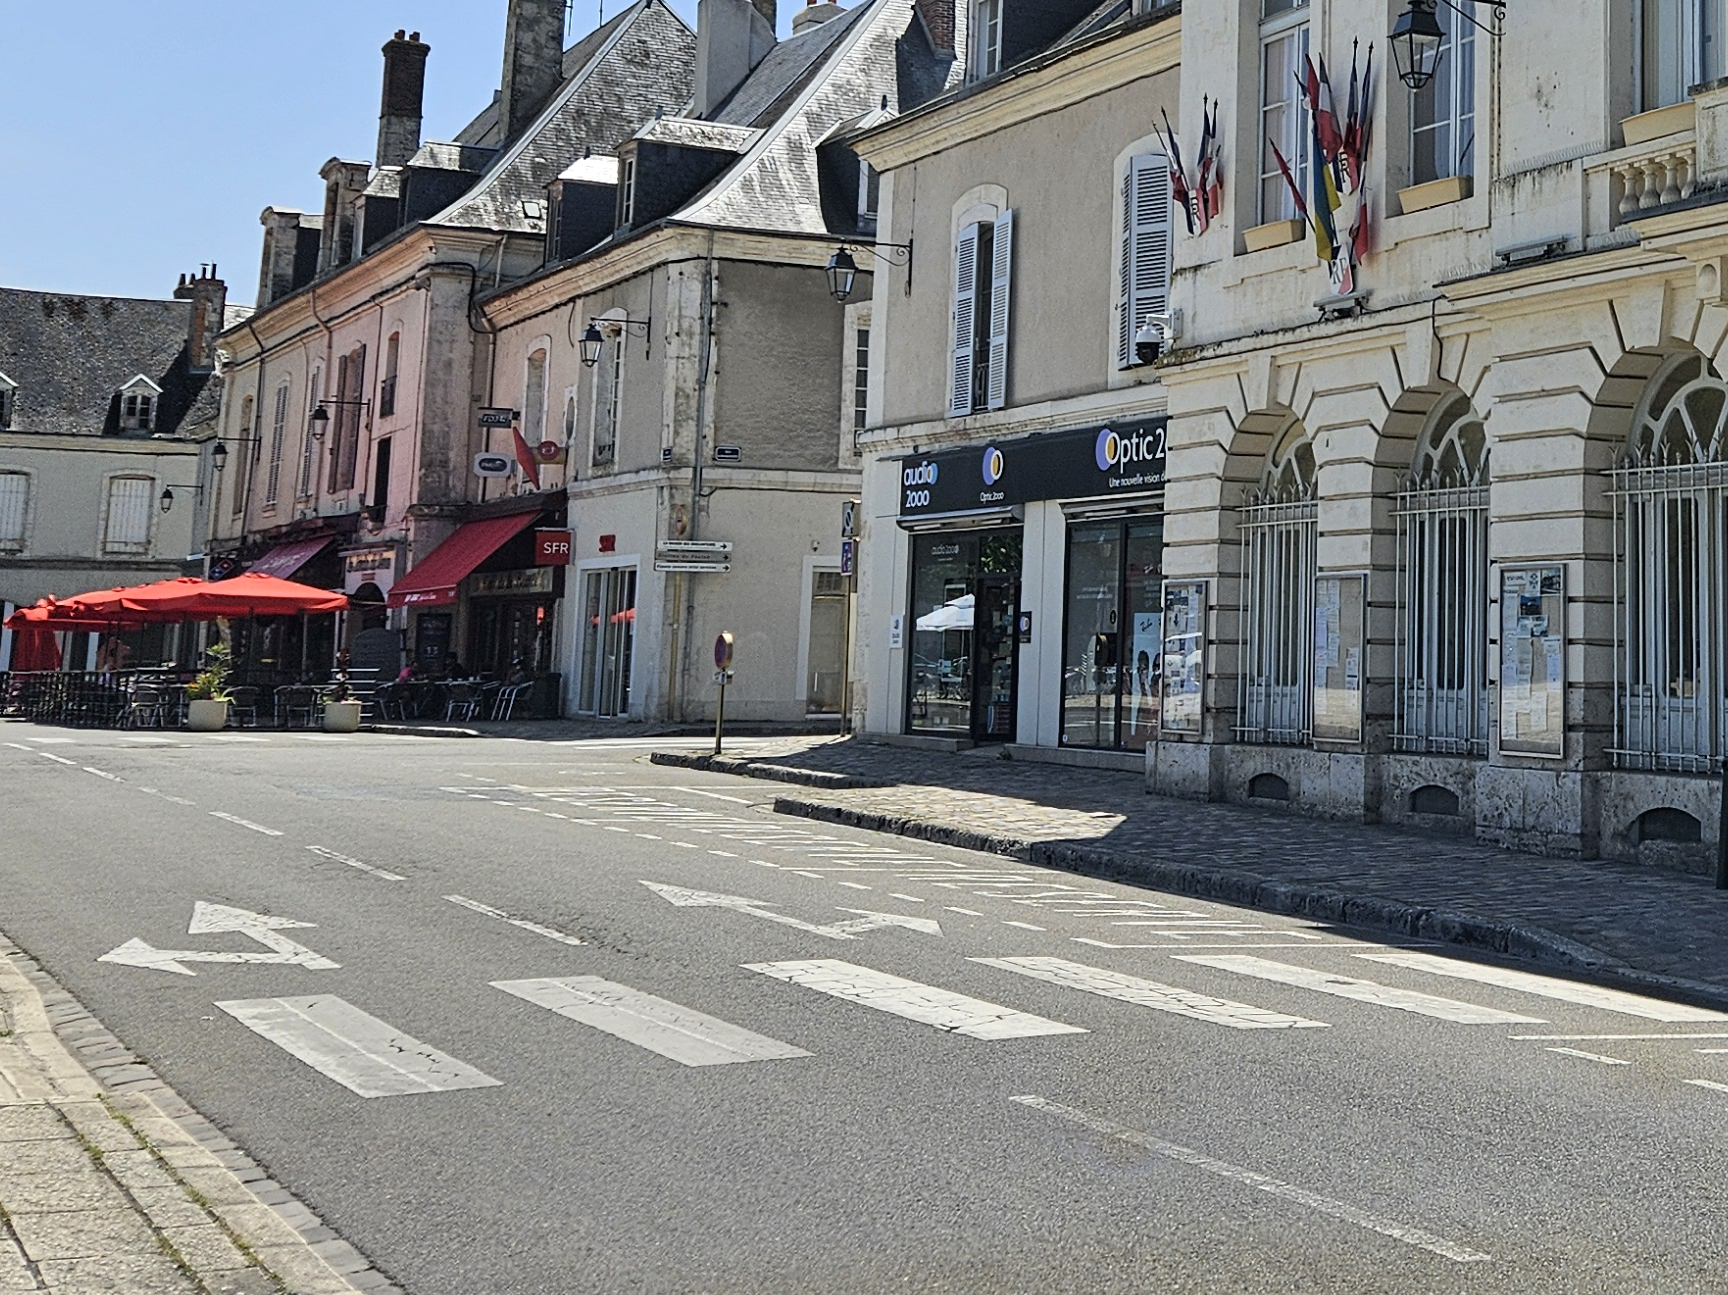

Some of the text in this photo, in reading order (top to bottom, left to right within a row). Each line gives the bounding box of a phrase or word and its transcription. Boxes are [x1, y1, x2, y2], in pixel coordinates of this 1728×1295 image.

[1105, 427, 1168, 475] Optic 2
[904, 460, 933, 487] audio
[1109, 477, 1120, 488] Une
[1144, 473, 1160, 484] vision
[905, 489, 930, 508] 2000
[543, 542, 569, 554] SFR
